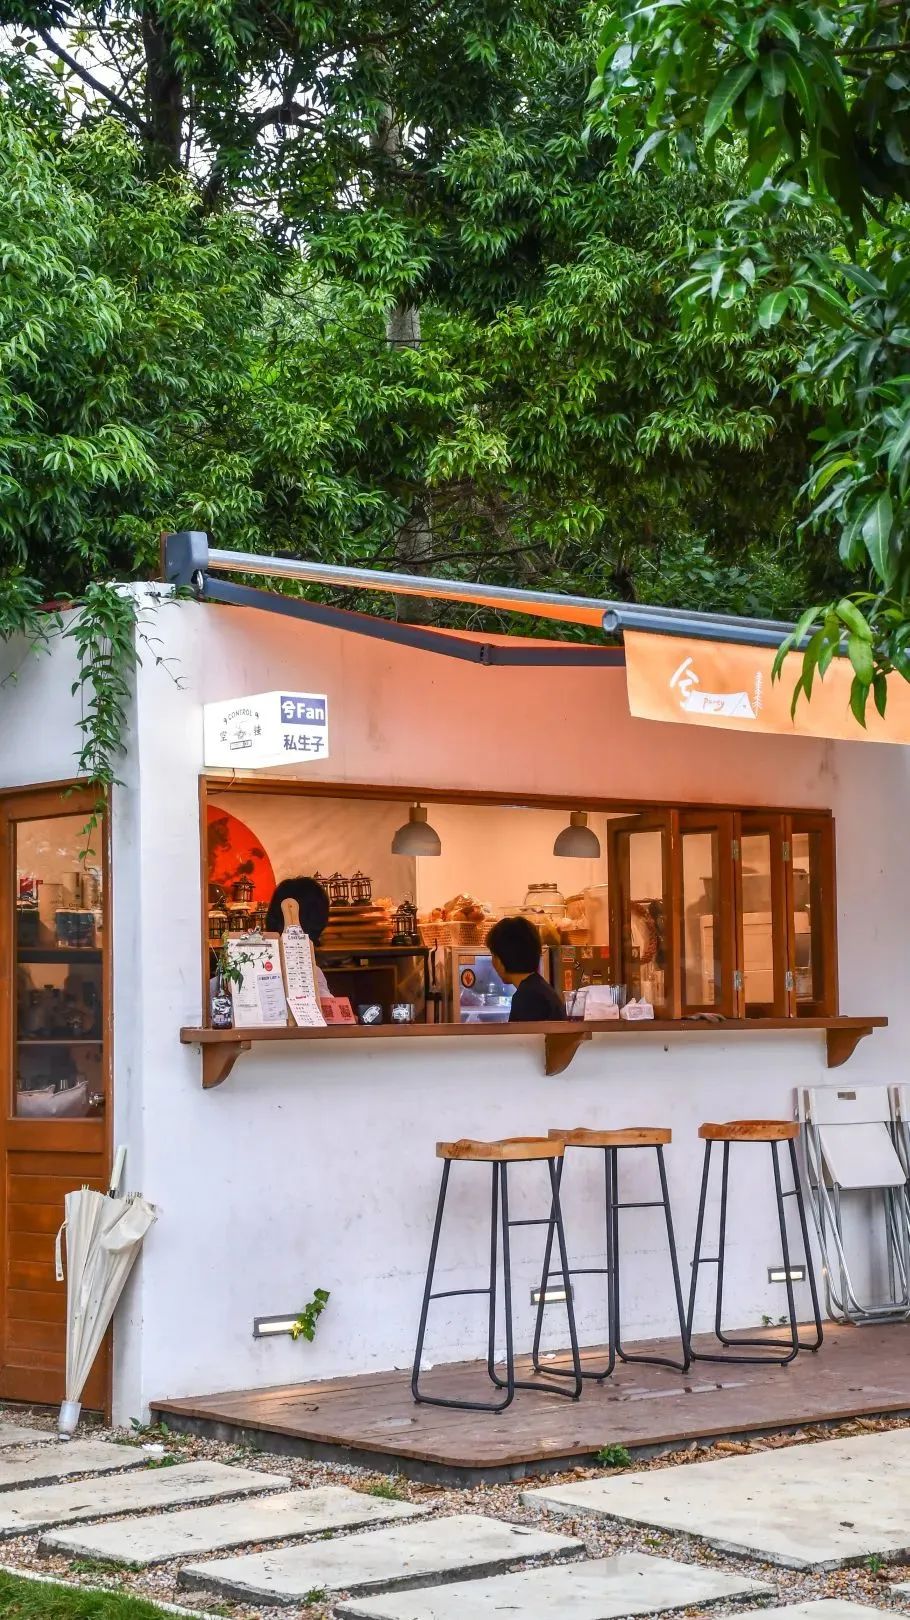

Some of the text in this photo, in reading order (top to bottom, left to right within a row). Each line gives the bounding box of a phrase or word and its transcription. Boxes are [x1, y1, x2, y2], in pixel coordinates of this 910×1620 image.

[228, 708, 253, 720] CONTROL
[283, 734, 325, 752] 私生子
